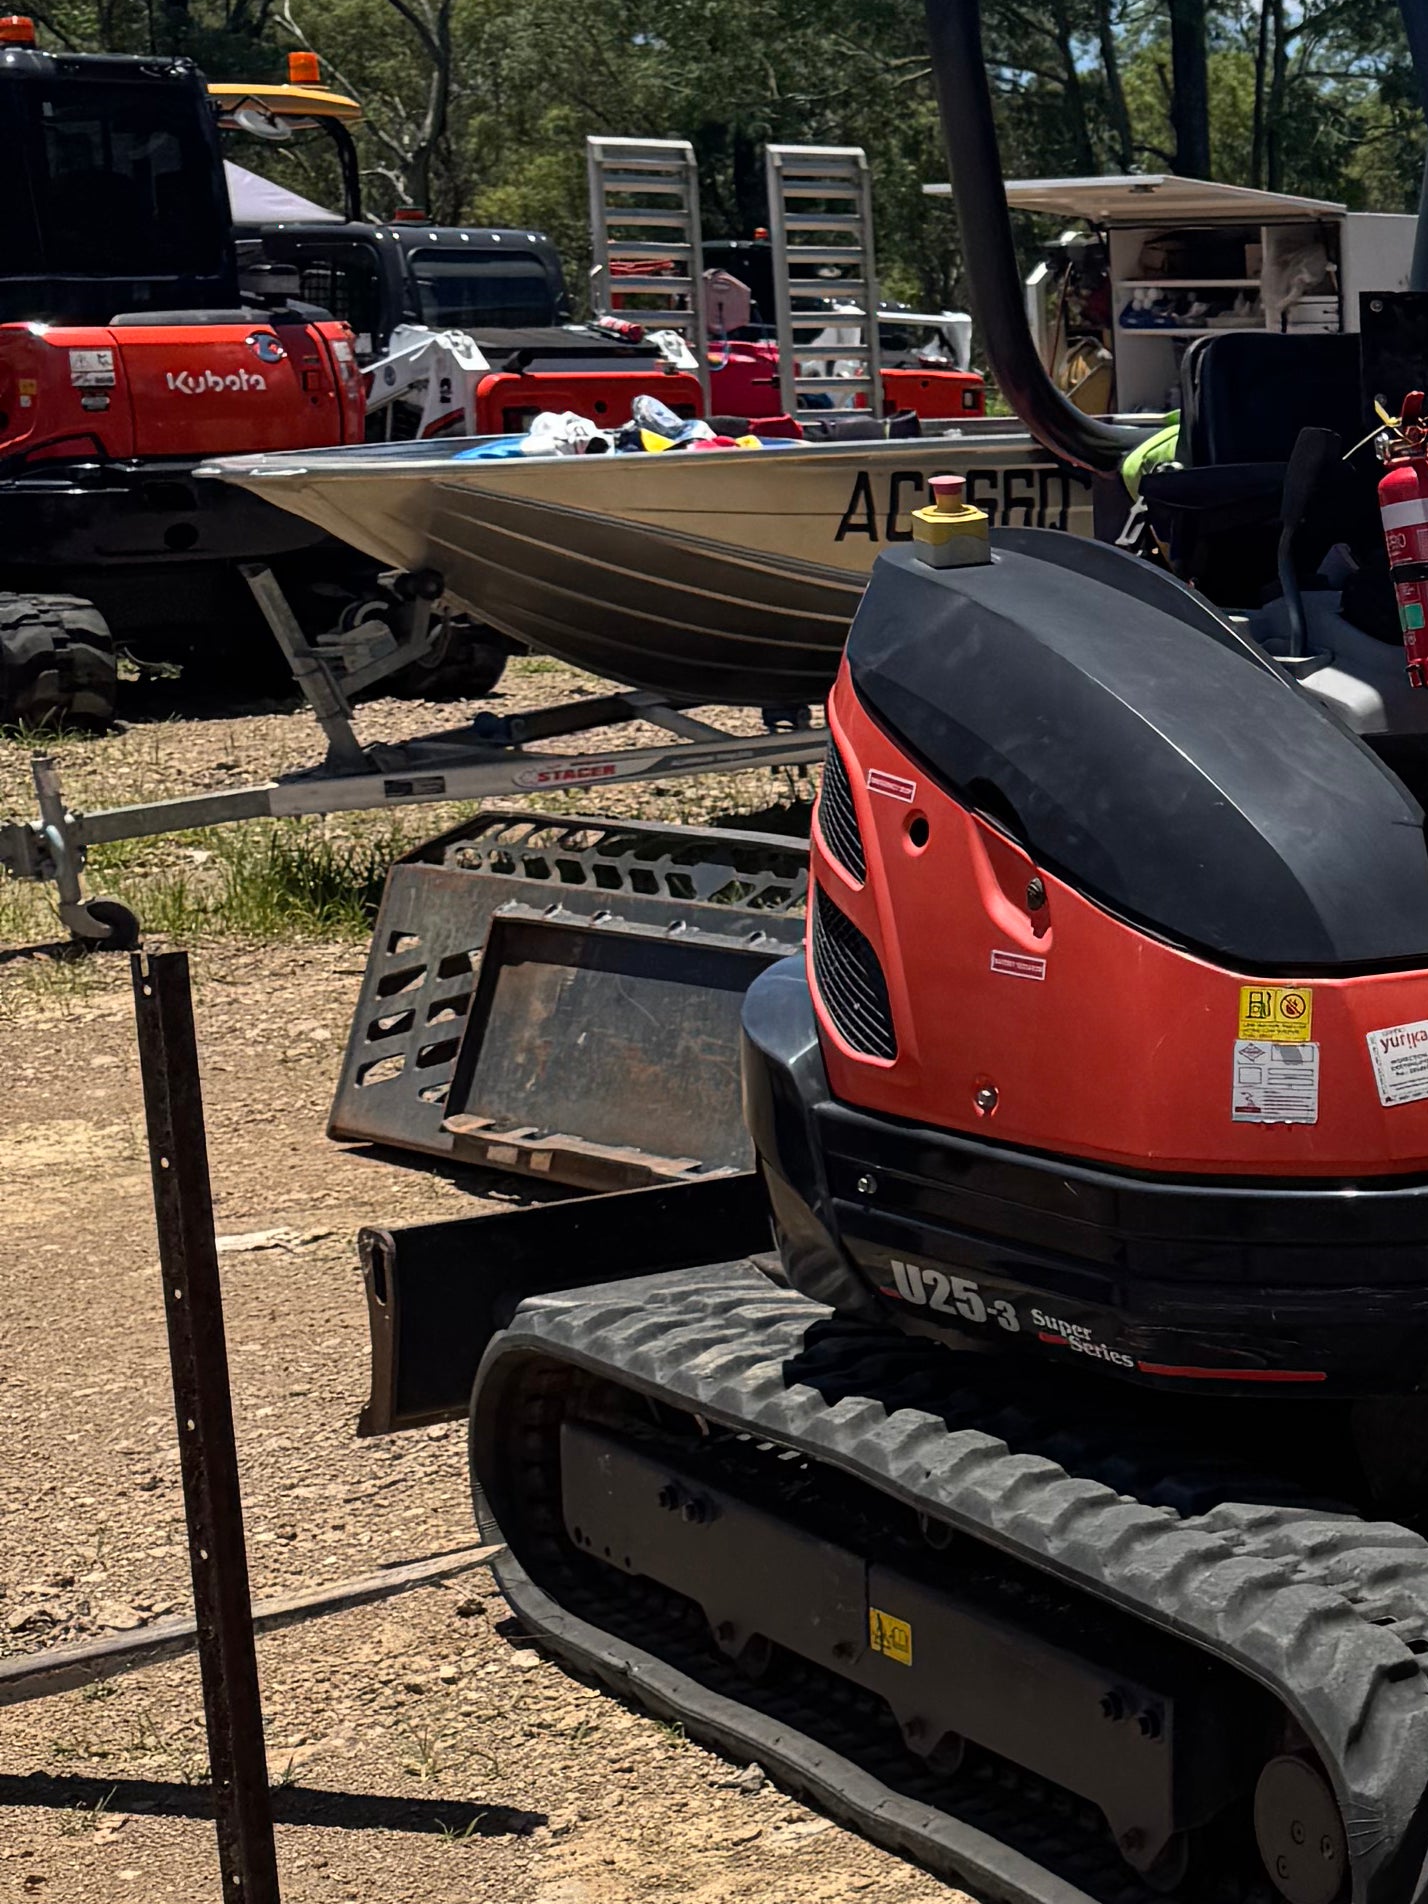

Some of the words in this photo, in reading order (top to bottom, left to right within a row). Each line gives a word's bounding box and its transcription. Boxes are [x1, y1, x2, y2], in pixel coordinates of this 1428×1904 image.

[166, 368, 267, 394] Kubota
[537, 764, 617, 783] STACER
[1379, 1029, 1428, 1054] yurika
[890, 1259, 1021, 1333] U25-3
[1030, 1308, 1093, 1341] Super
[1067, 1335, 1135, 1368] Series
